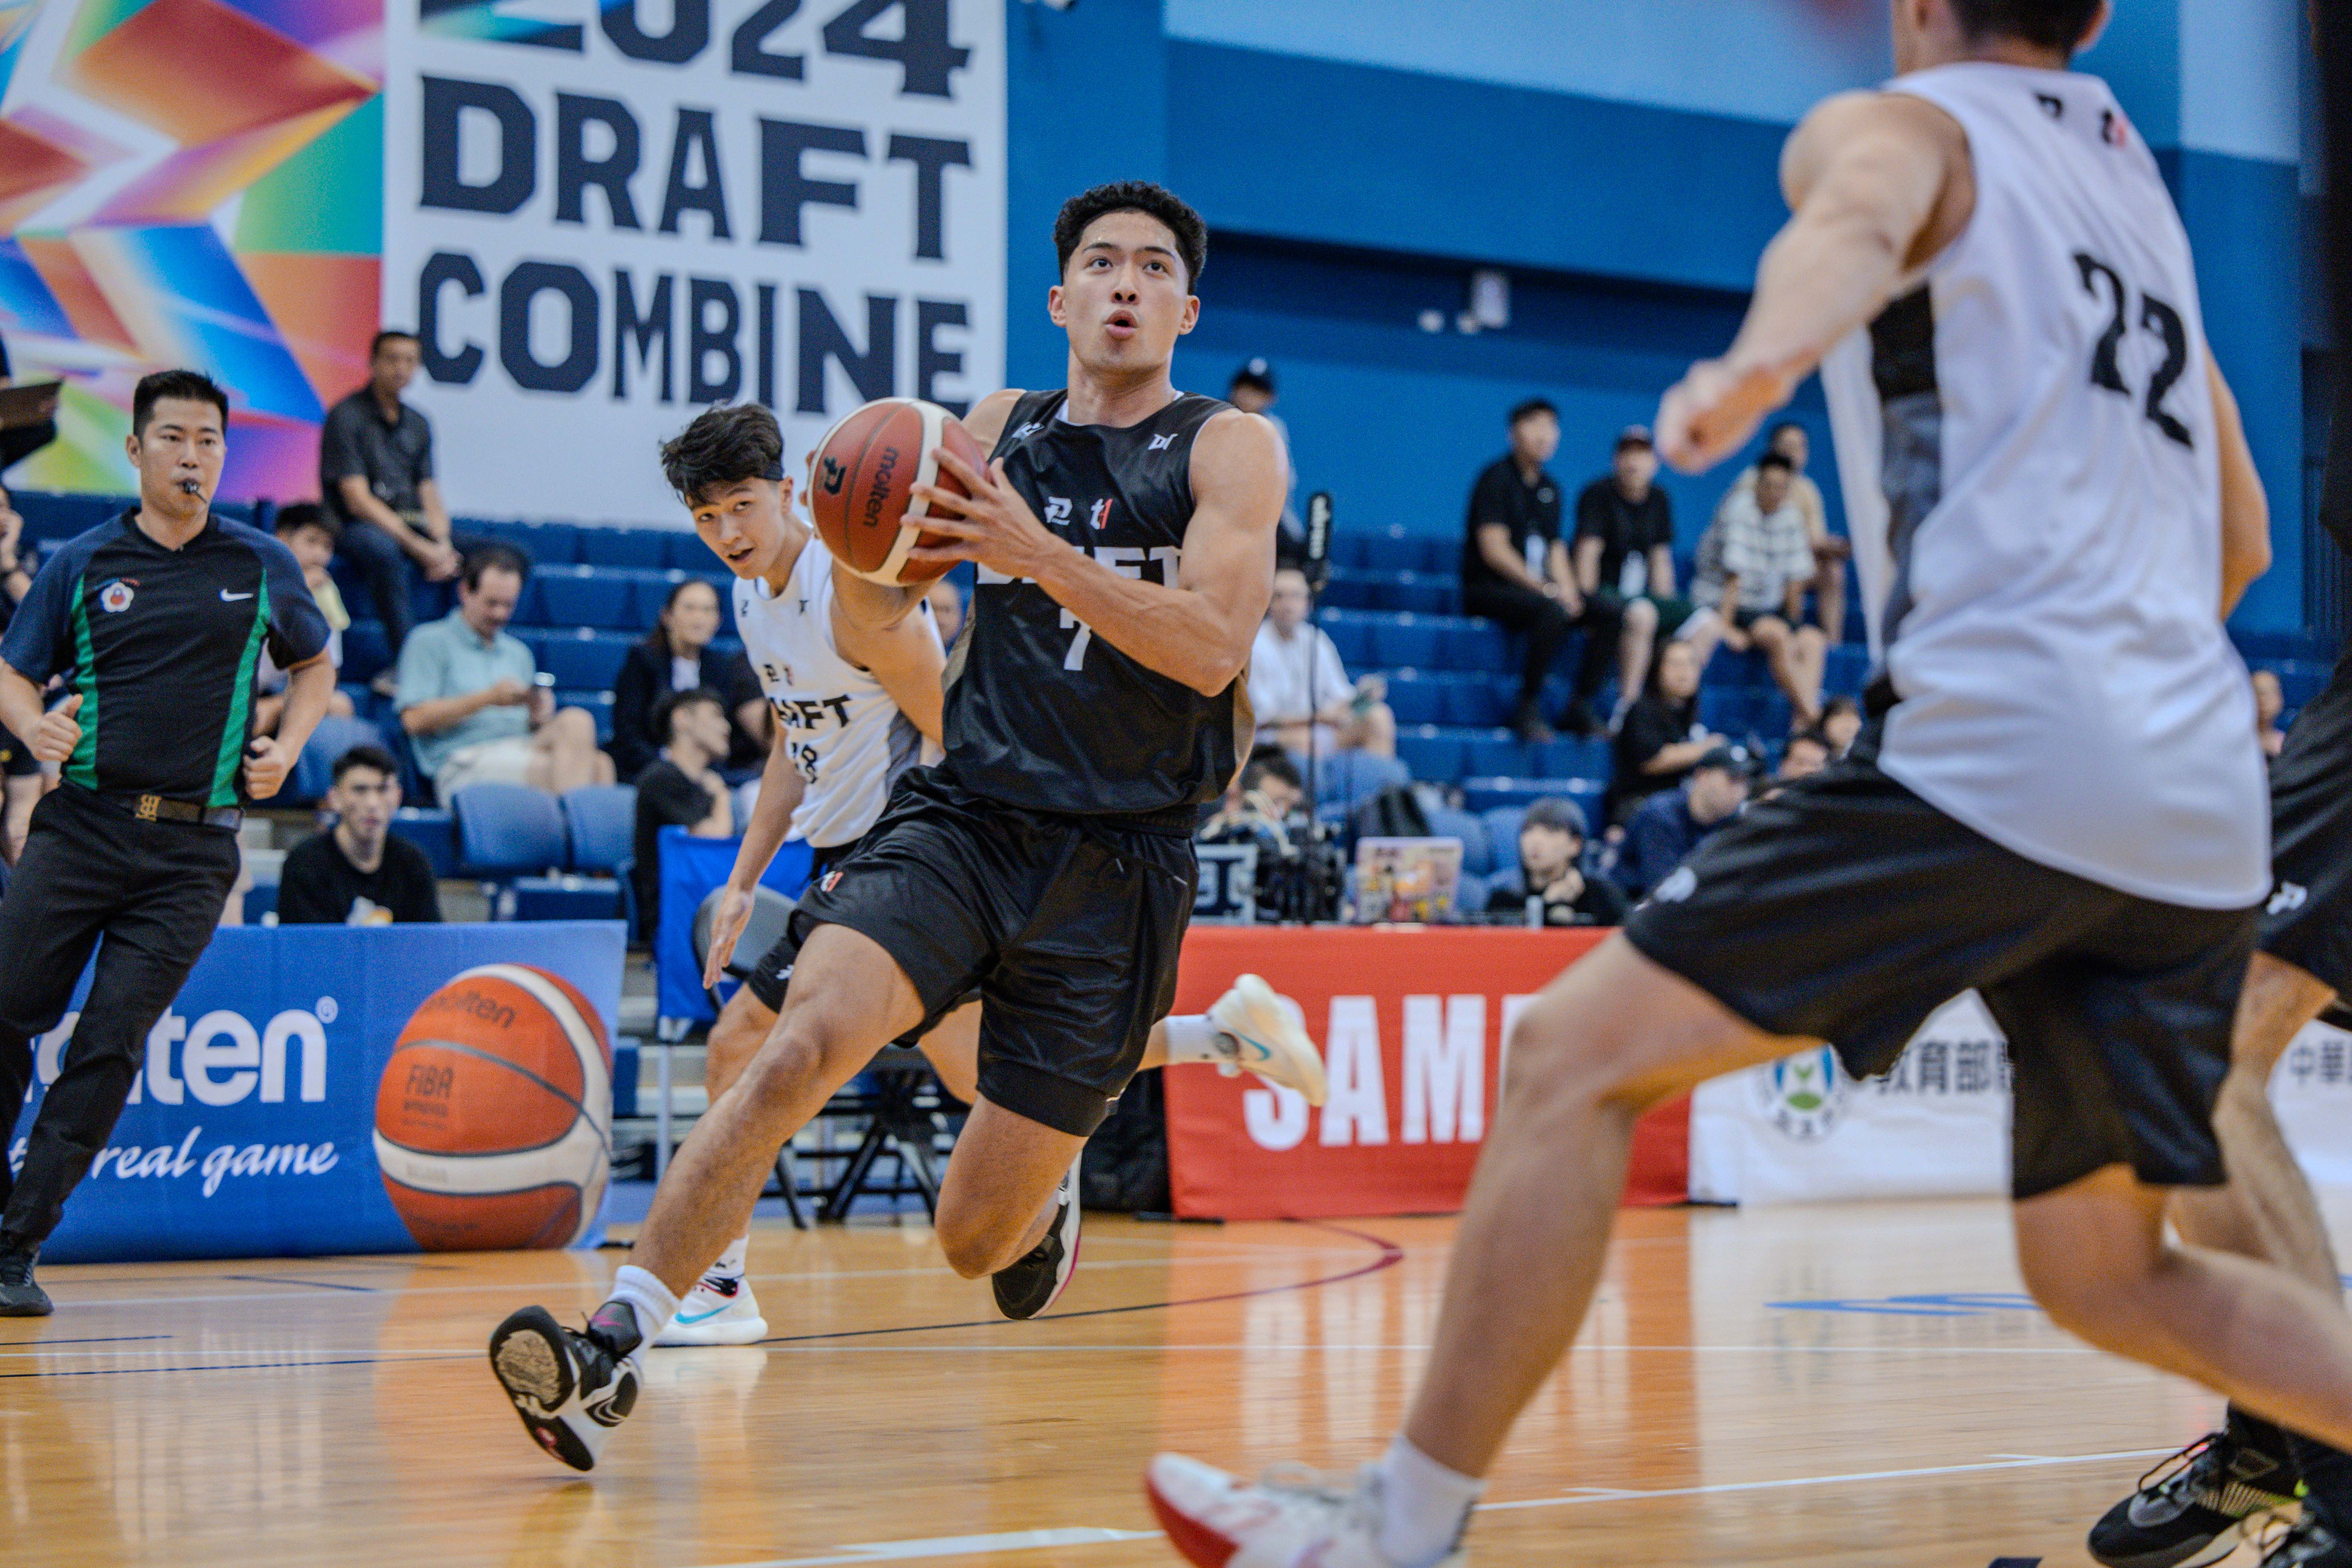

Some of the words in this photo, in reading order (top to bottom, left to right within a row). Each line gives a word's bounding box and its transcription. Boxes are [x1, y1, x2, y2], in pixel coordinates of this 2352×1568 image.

[419, 76, 972, 261] DRAFT
[419, 253, 970, 419] COMBINE
[2073, 252, 2195, 453] 22
[862, 446, 899, 529] molten
[1059, 607, 1092, 671] 7
[23, 1005, 328, 1106] ten
[407, 1064, 454, 1100] FIBA
[1242, 992, 1540, 1151] SAM
[2288, 1039, 2352, 1086] 中華
[91, 1125, 202, 1180] real
[201, 1141, 340, 1198] game
